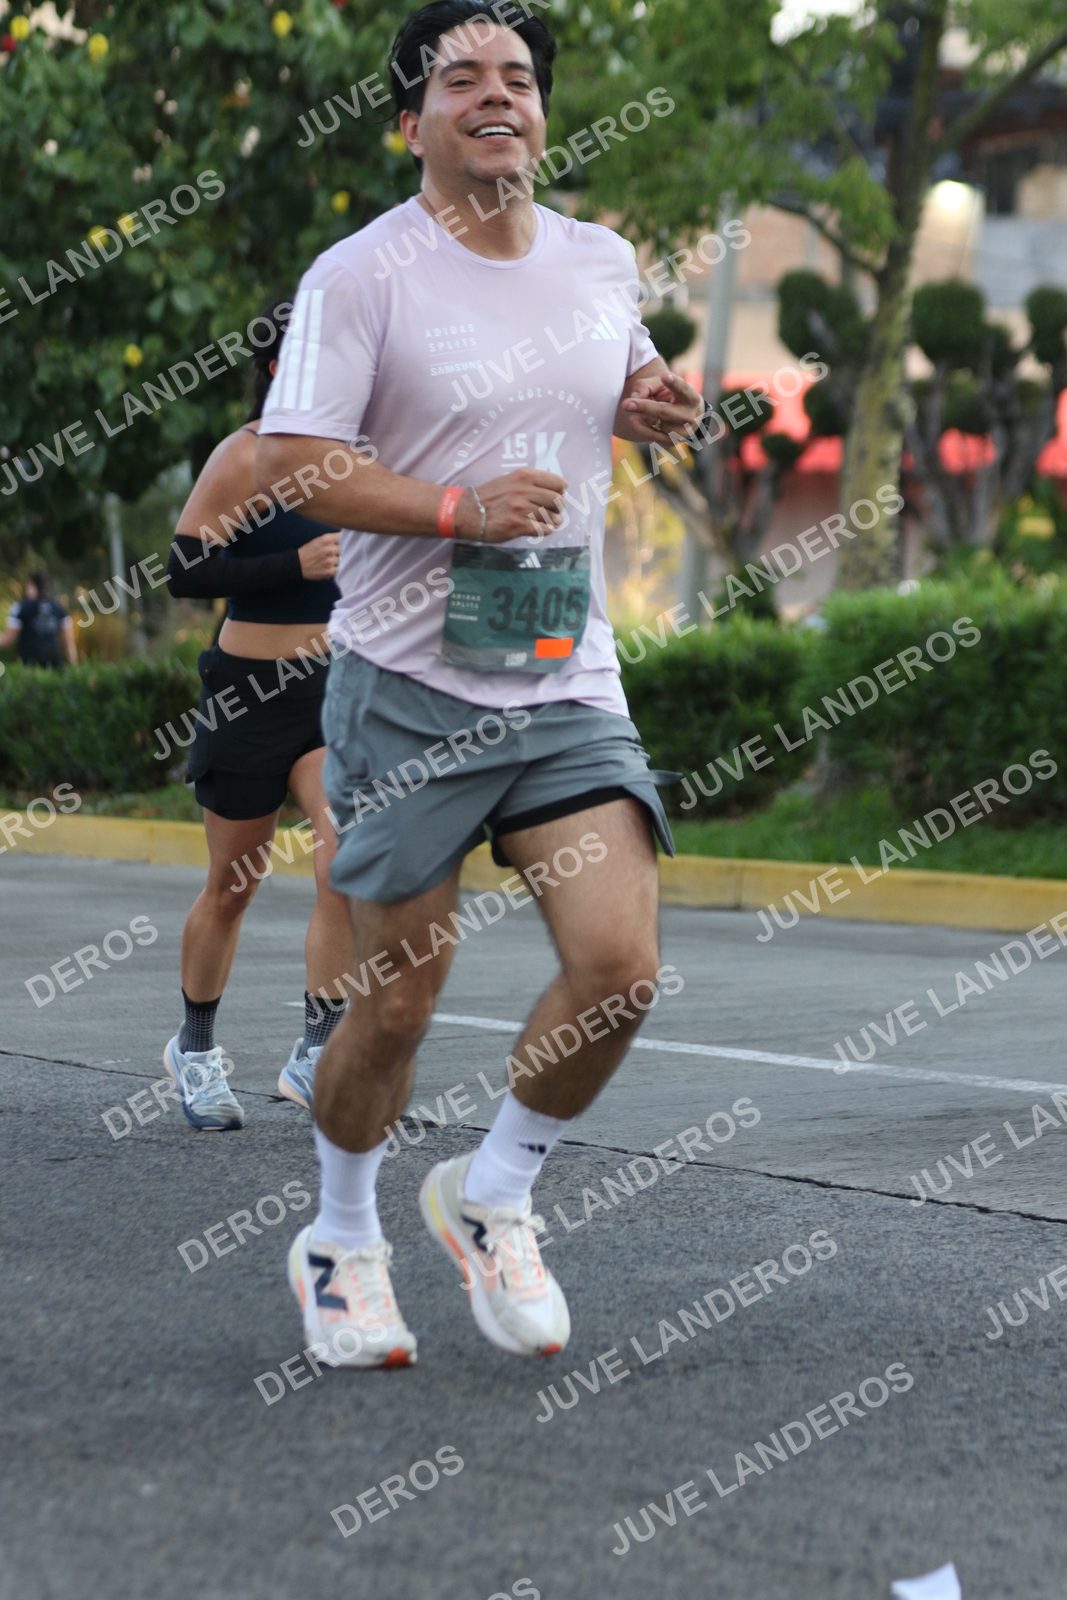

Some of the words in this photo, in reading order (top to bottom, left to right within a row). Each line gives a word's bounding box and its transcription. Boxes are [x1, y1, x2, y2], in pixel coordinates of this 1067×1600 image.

[501, 432, 528, 459] 15
[534, 431, 567, 480] K
[487, 585, 585, 632] 3405
